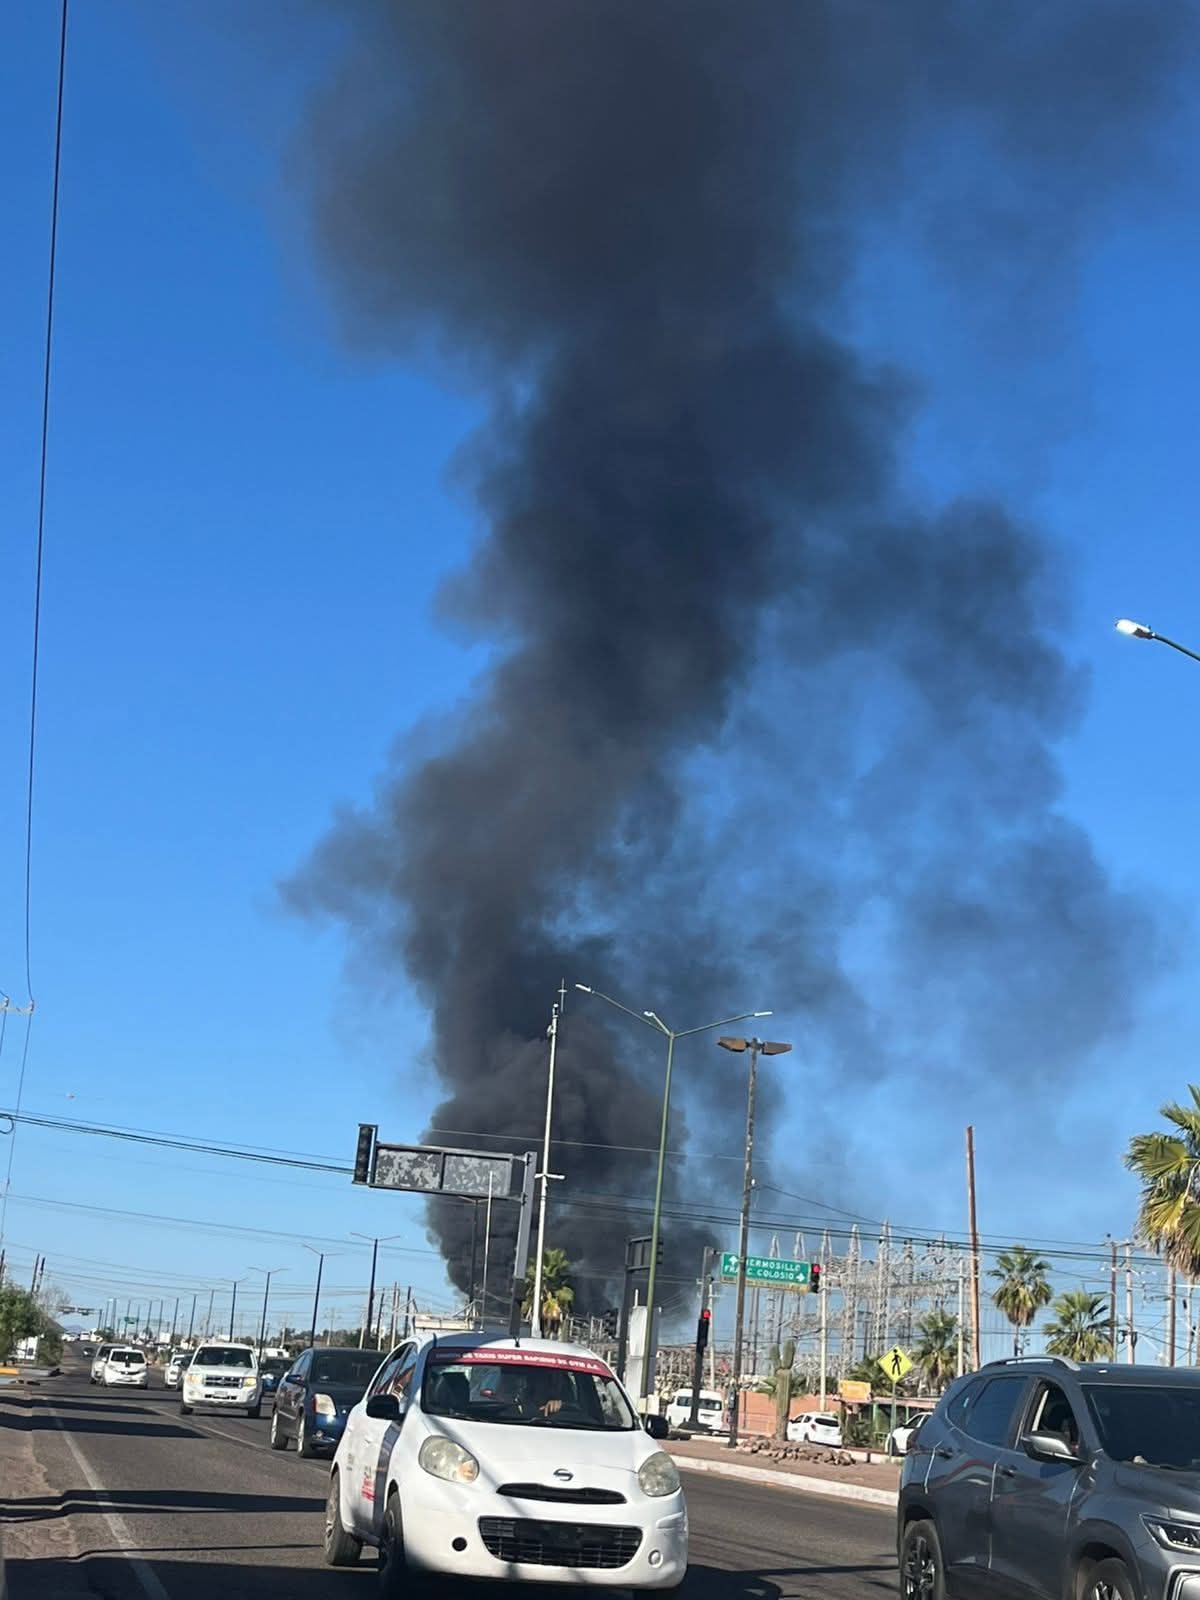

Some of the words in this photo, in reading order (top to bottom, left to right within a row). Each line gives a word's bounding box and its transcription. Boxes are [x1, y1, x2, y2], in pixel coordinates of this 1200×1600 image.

[756, 1270, 794, 1280] COLOSIO
[473, 1352, 497, 1360] TAXIS
[497, 1353, 523, 1361] SUPER
